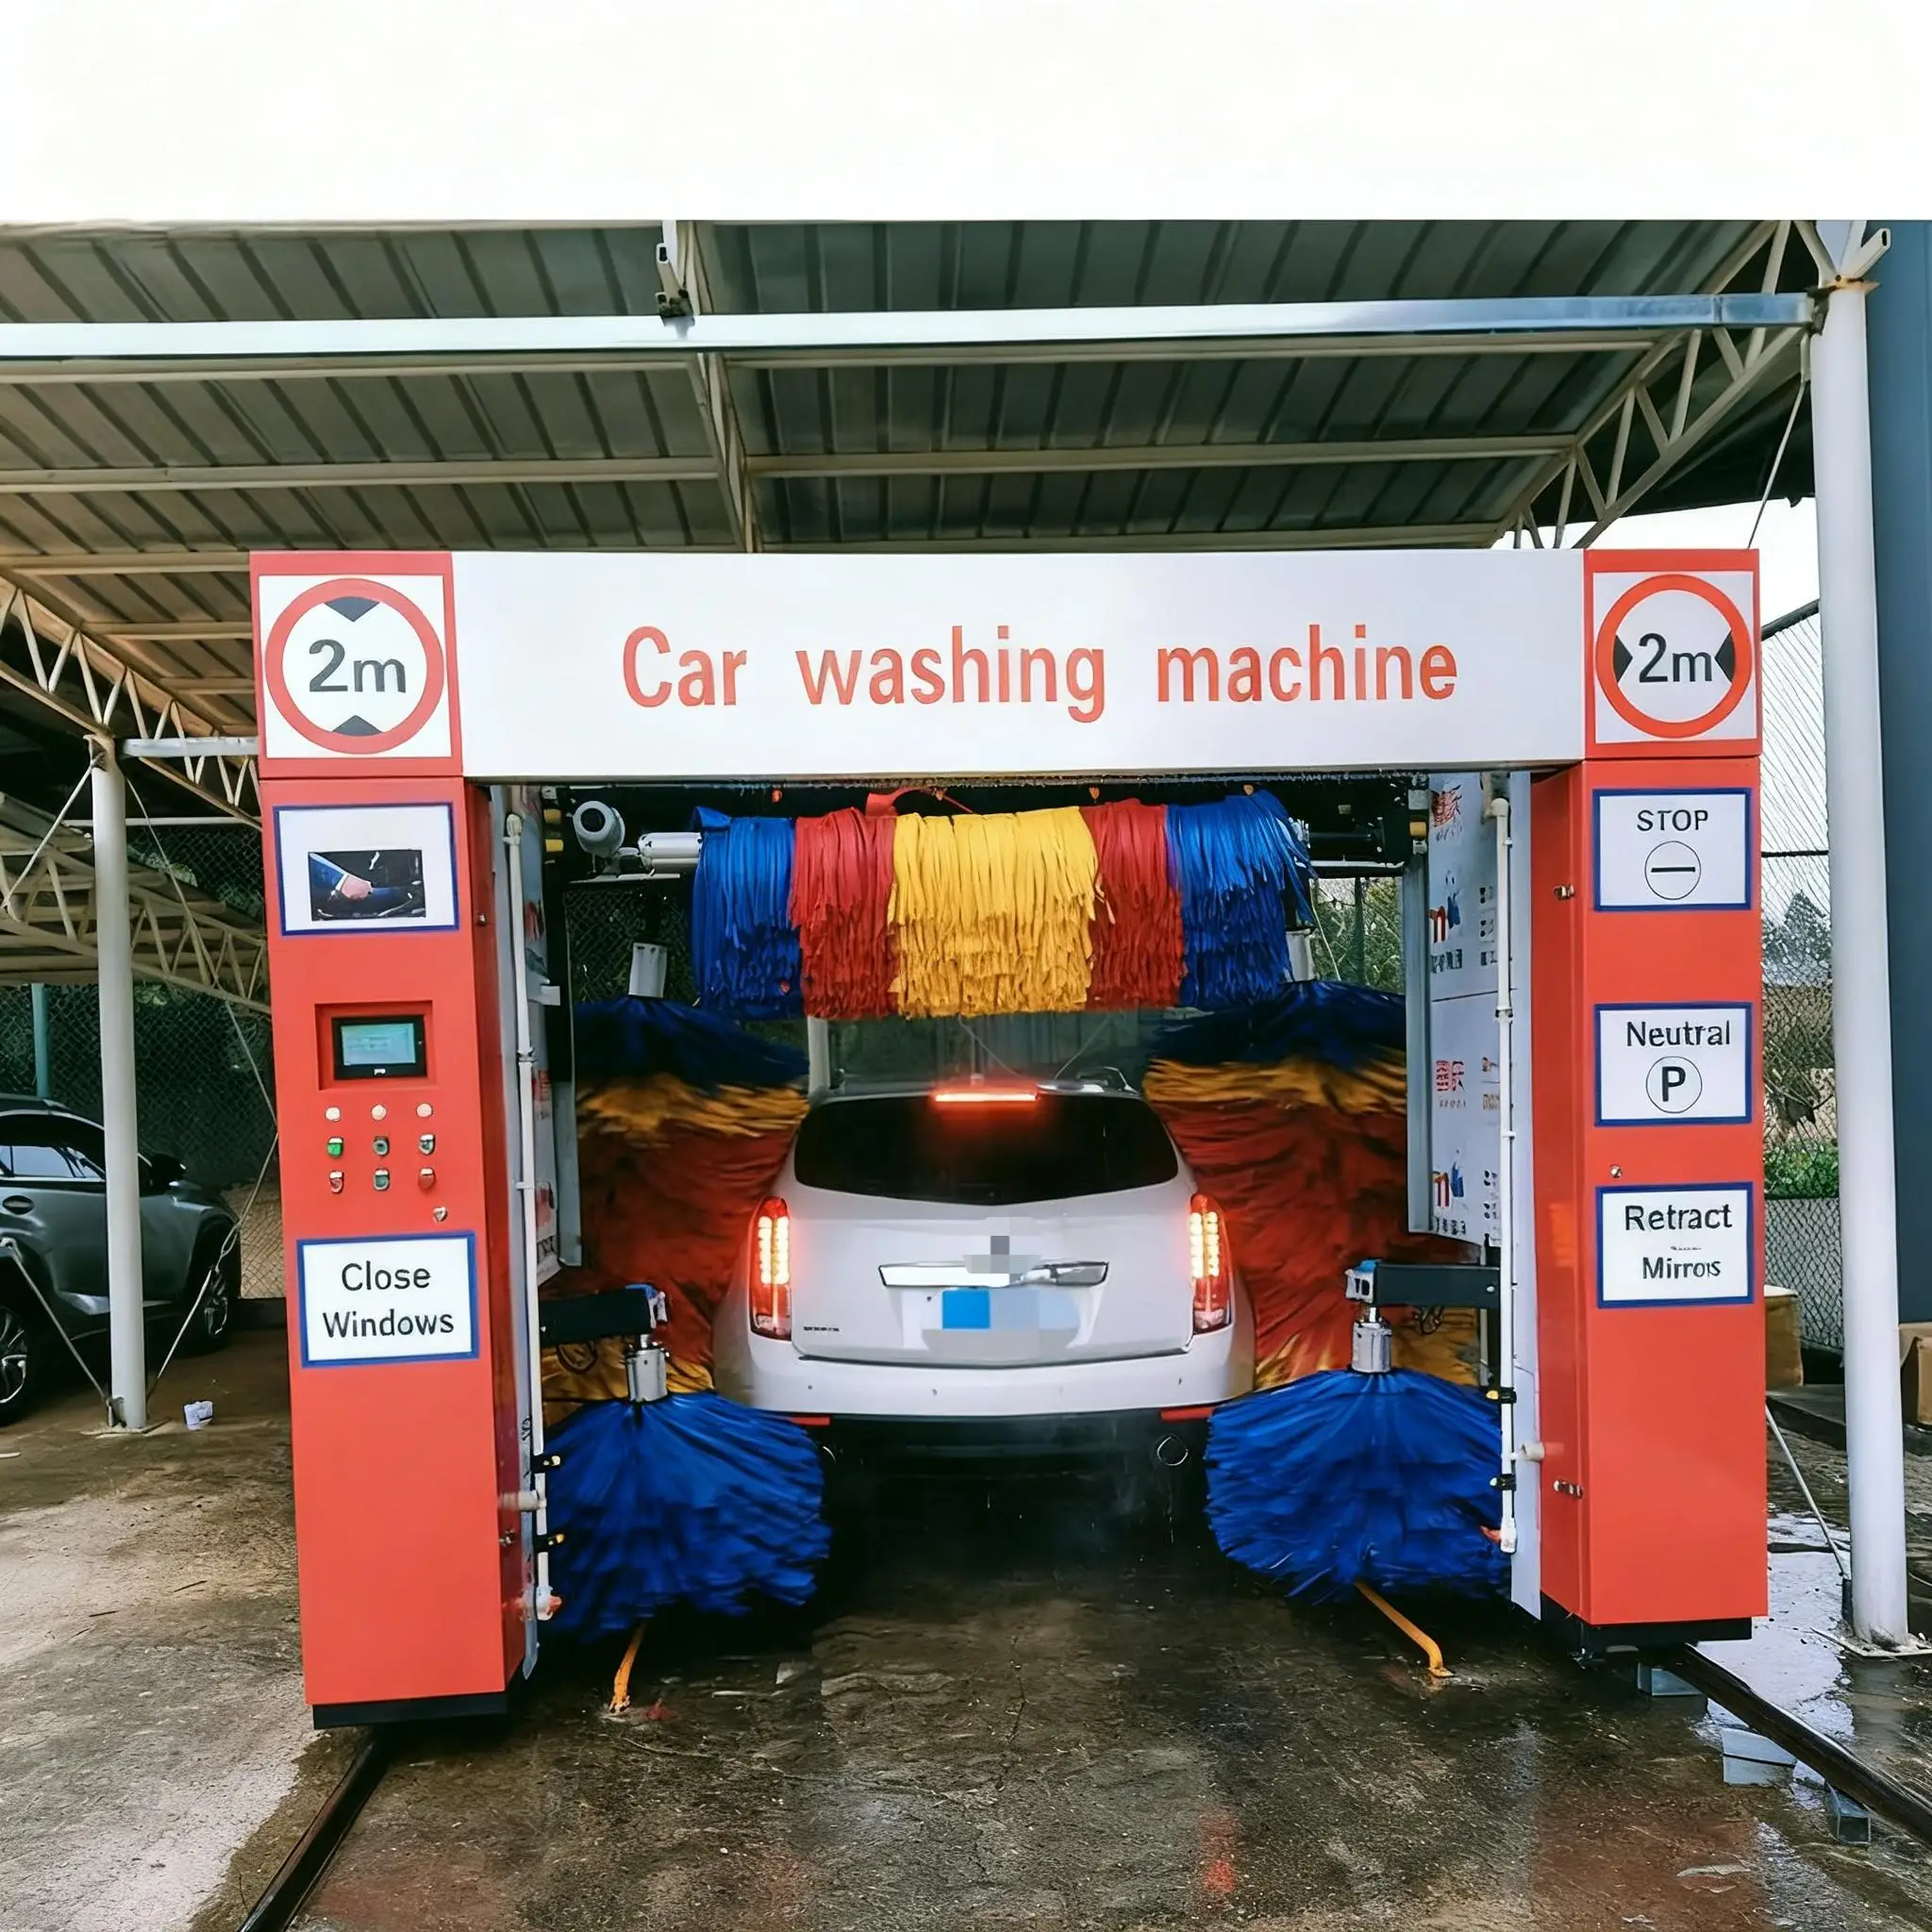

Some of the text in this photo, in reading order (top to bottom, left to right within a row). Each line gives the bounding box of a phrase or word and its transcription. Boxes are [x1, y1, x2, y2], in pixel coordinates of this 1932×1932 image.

[308, 639, 407, 693] 2m
[623, 625, 1457, 724] Car washing machine
[1638, 632, 1713, 684] 2m
[1637, 808, 1708, 832] STOP
[1626, 1020, 1731, 1047] Neutral
[1660, 1066, 1687, 1103] P
[1624, 1204, 1733, 1231] Retract
[341, 1260, 431, 1291] Close
[322, 1307, 455, 1340] Windows
